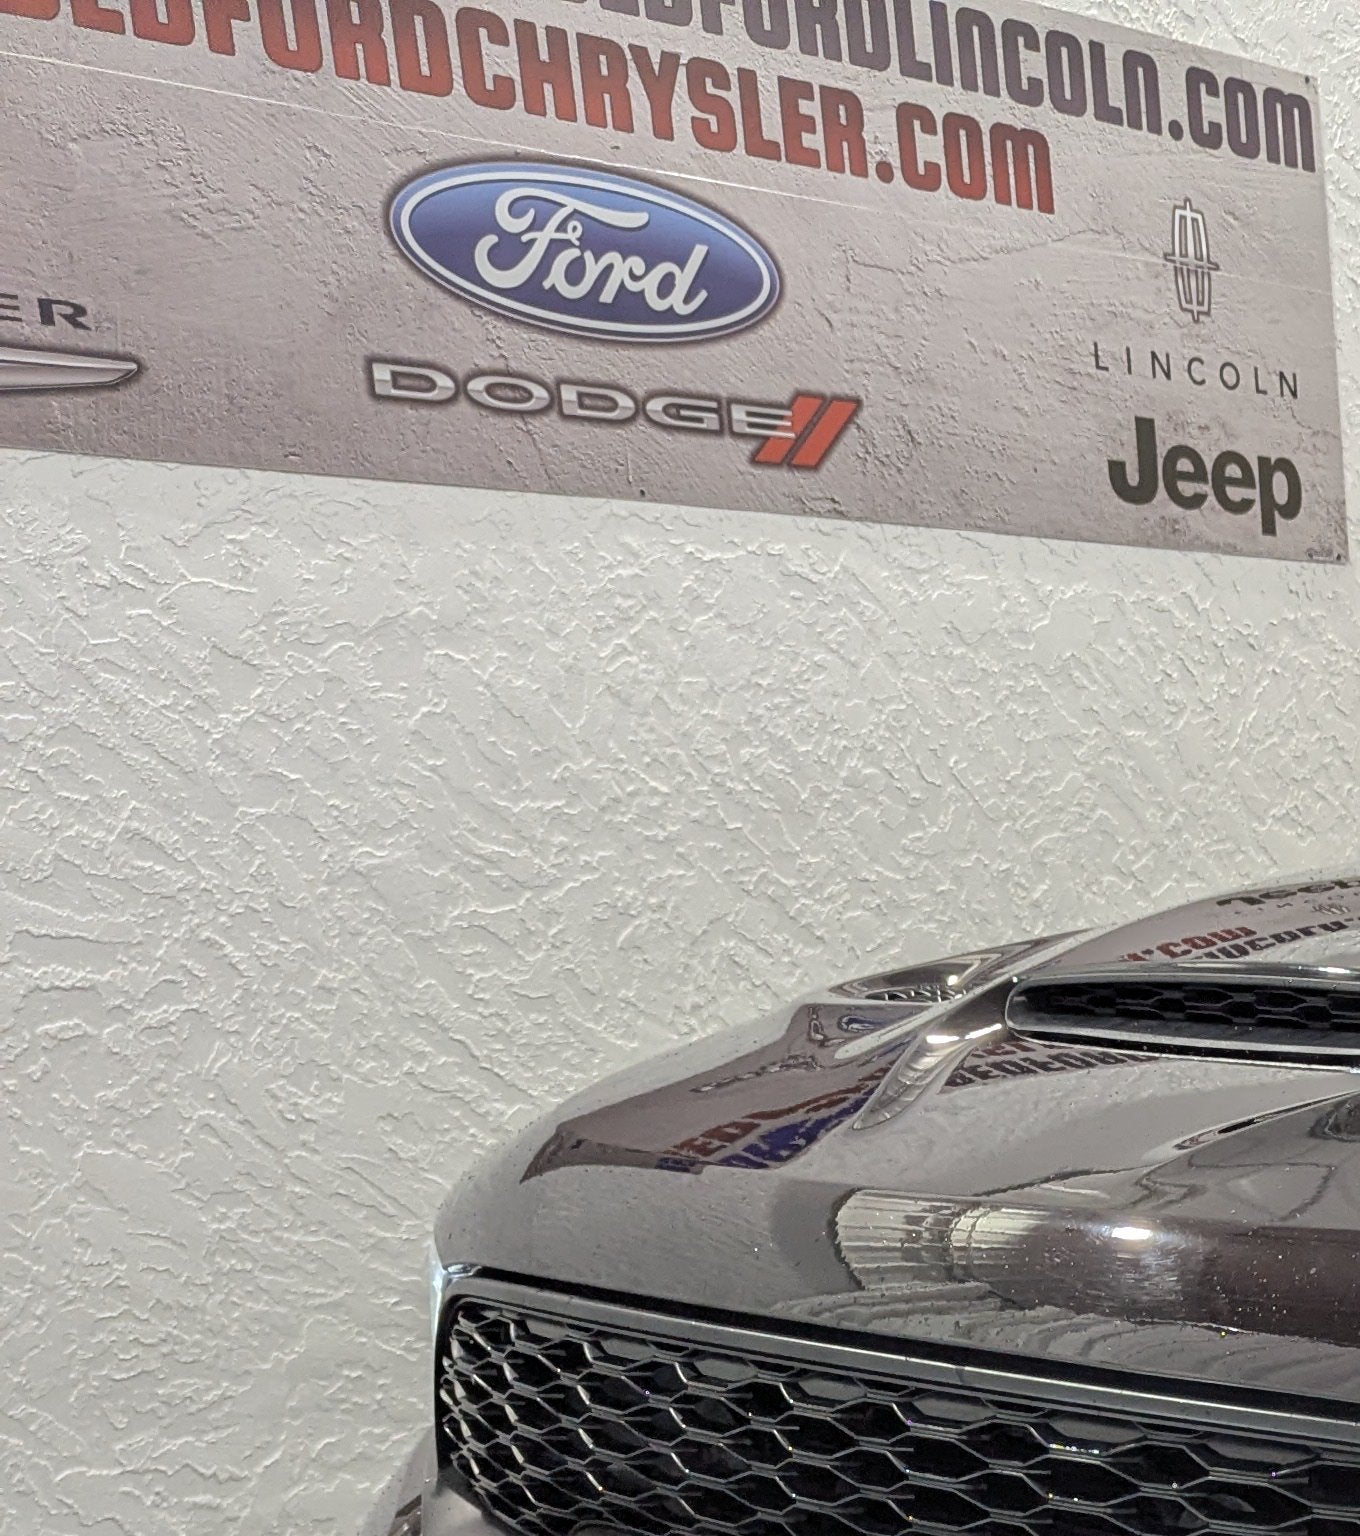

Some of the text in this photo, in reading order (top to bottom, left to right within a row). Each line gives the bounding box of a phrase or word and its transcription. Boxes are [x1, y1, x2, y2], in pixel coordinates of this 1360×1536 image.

[564, 0, 1317, 173] ORDLINCOLN.COM
[474, 185, 710, 317] Ford
[370, 361, 797, 440] DODGE
[1093, 341, 1299, 400] LINCOLN
[1107, 415, 1303, 537] Jeep
